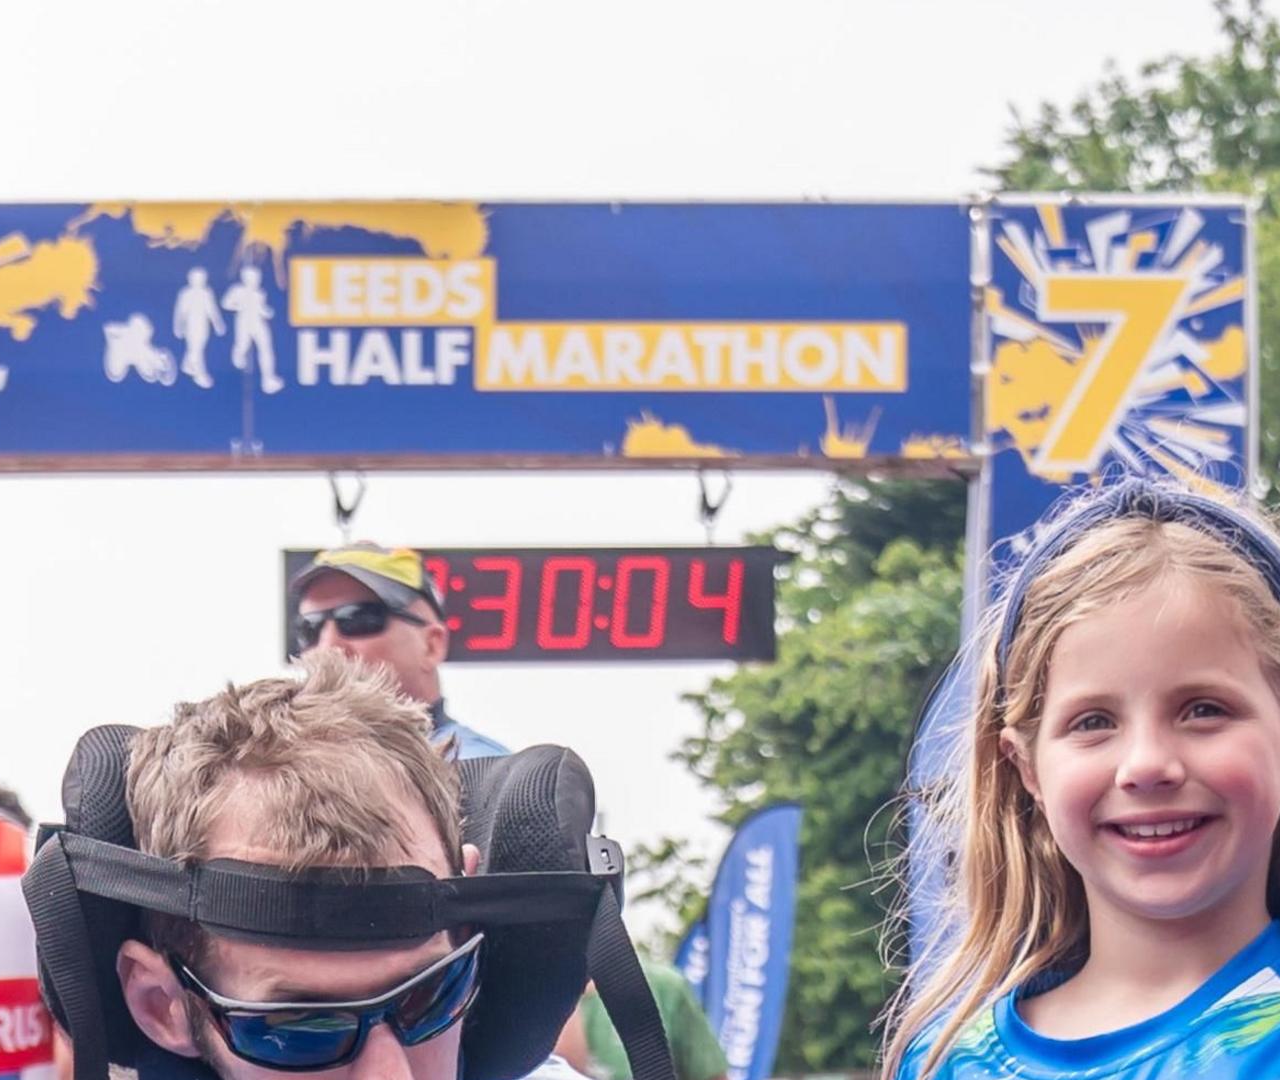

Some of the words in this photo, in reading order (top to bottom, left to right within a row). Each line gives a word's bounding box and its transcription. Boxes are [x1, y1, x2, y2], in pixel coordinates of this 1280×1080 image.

[296, 264, 486, 318] LEEDS
[296, 331, 472, 387] HALF
[484, 329, 898, 388] MARATHON
[1037, 273, 1191, 471] 7
[745, 845, 774, 910] ALL
